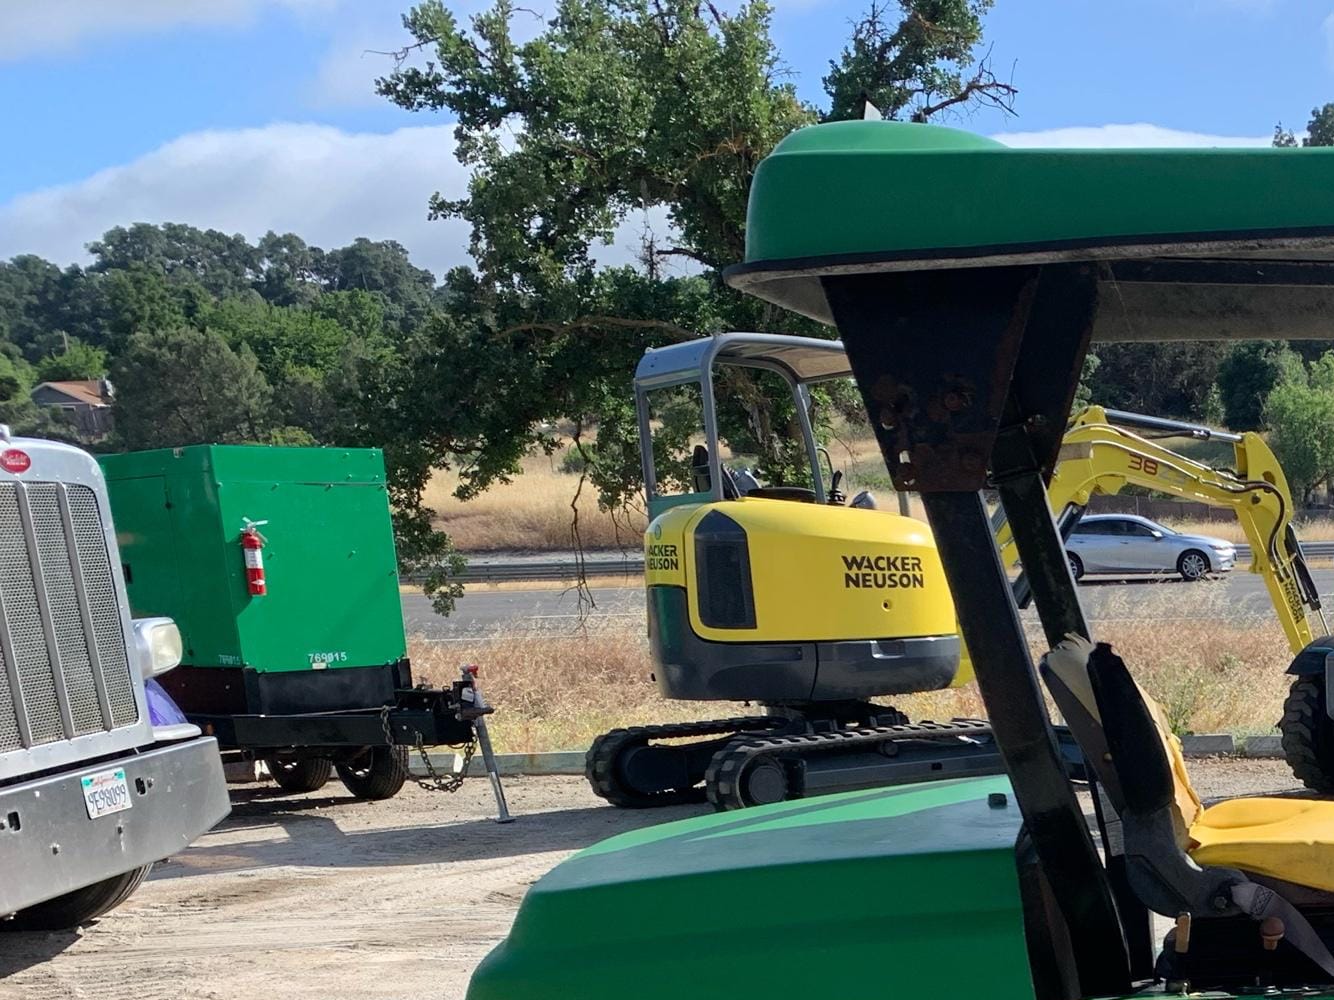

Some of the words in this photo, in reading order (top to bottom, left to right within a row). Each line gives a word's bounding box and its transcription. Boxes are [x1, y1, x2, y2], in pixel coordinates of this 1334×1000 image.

[650, 557, 679, 570] EUSON
[841, 555, 923, 572] WACKER
[845, 572, 924, 589] NEUSON
[308, 651, 347, 664] 769015
